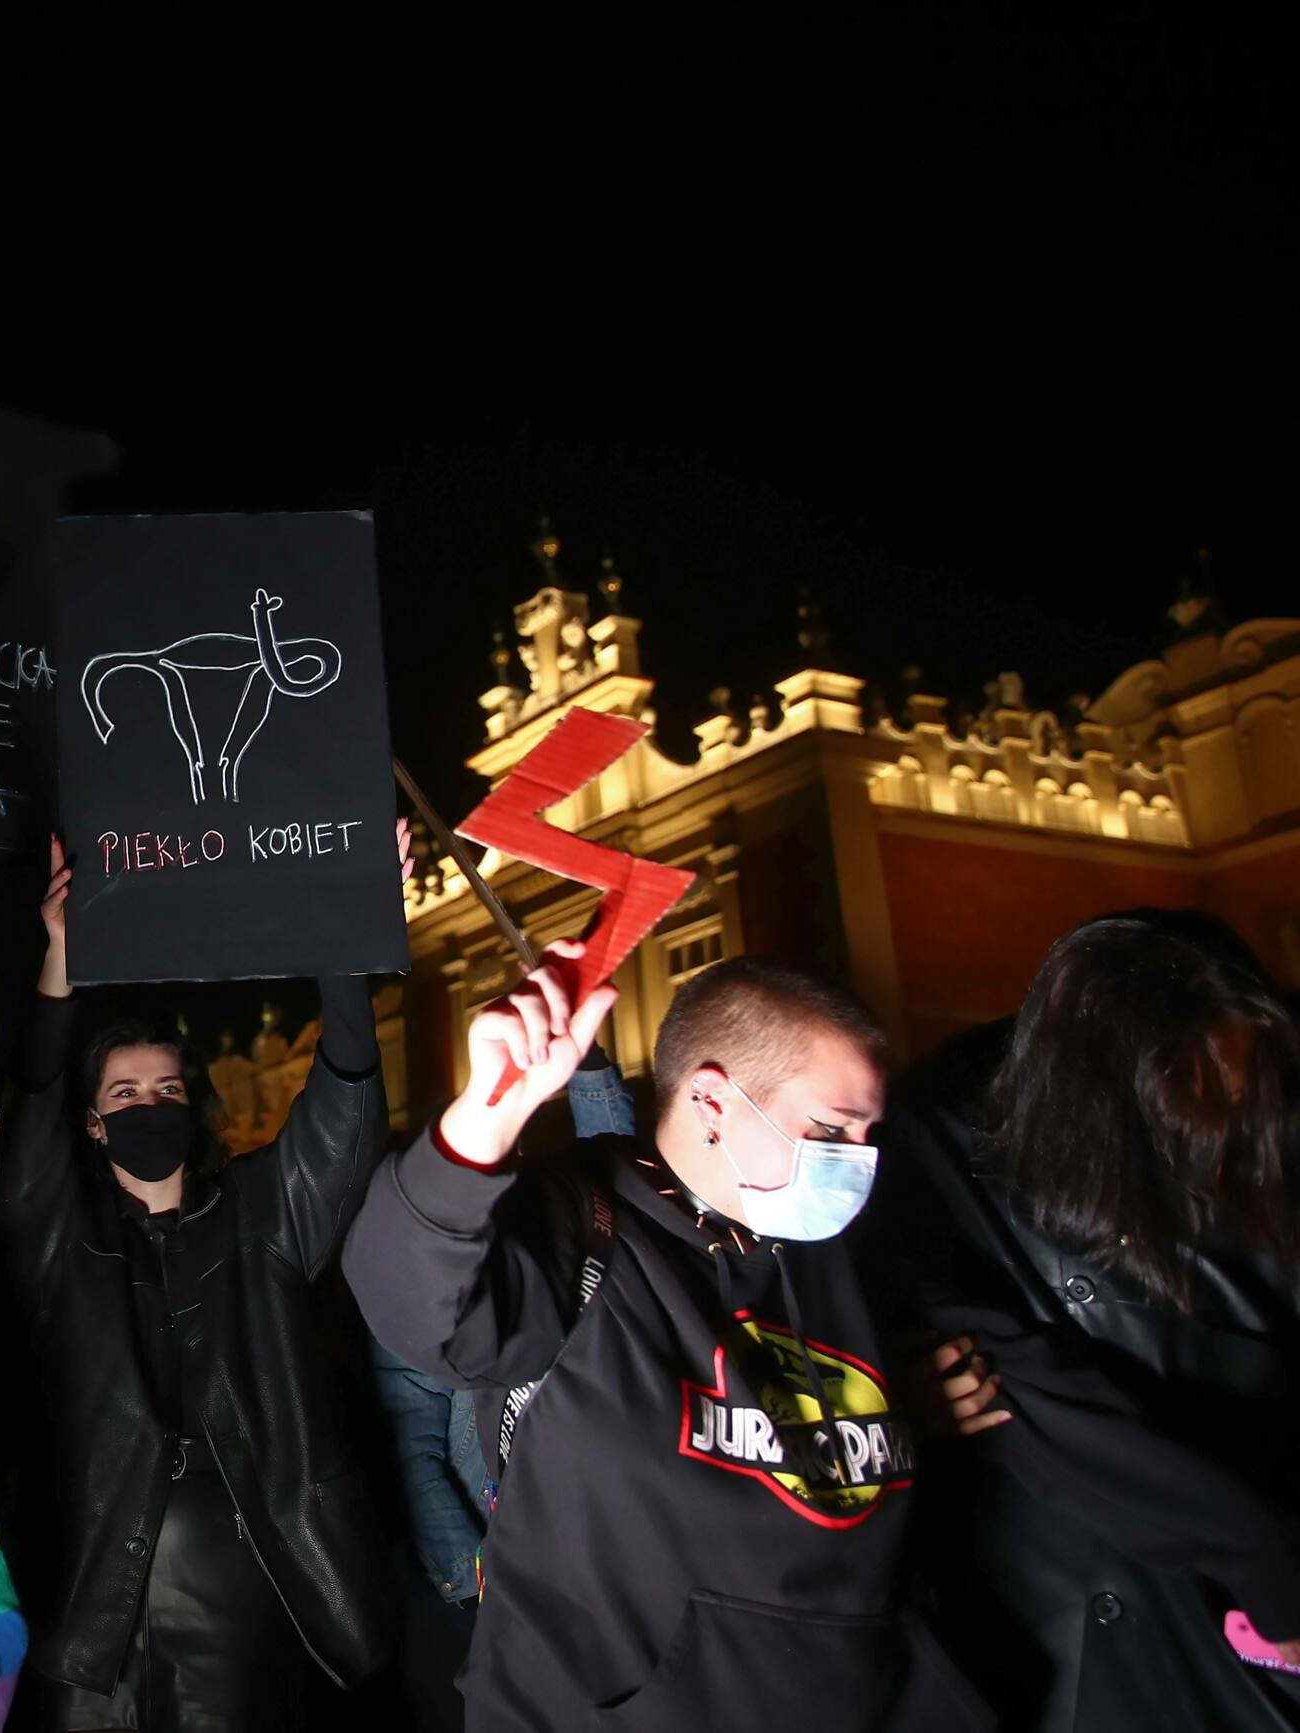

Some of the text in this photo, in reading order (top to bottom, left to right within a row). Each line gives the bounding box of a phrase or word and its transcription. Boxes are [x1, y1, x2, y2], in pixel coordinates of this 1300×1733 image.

[97, 821, 363, 878] PIEKŁO KOBIET
[505, 1382, 535, 1418] OVE
